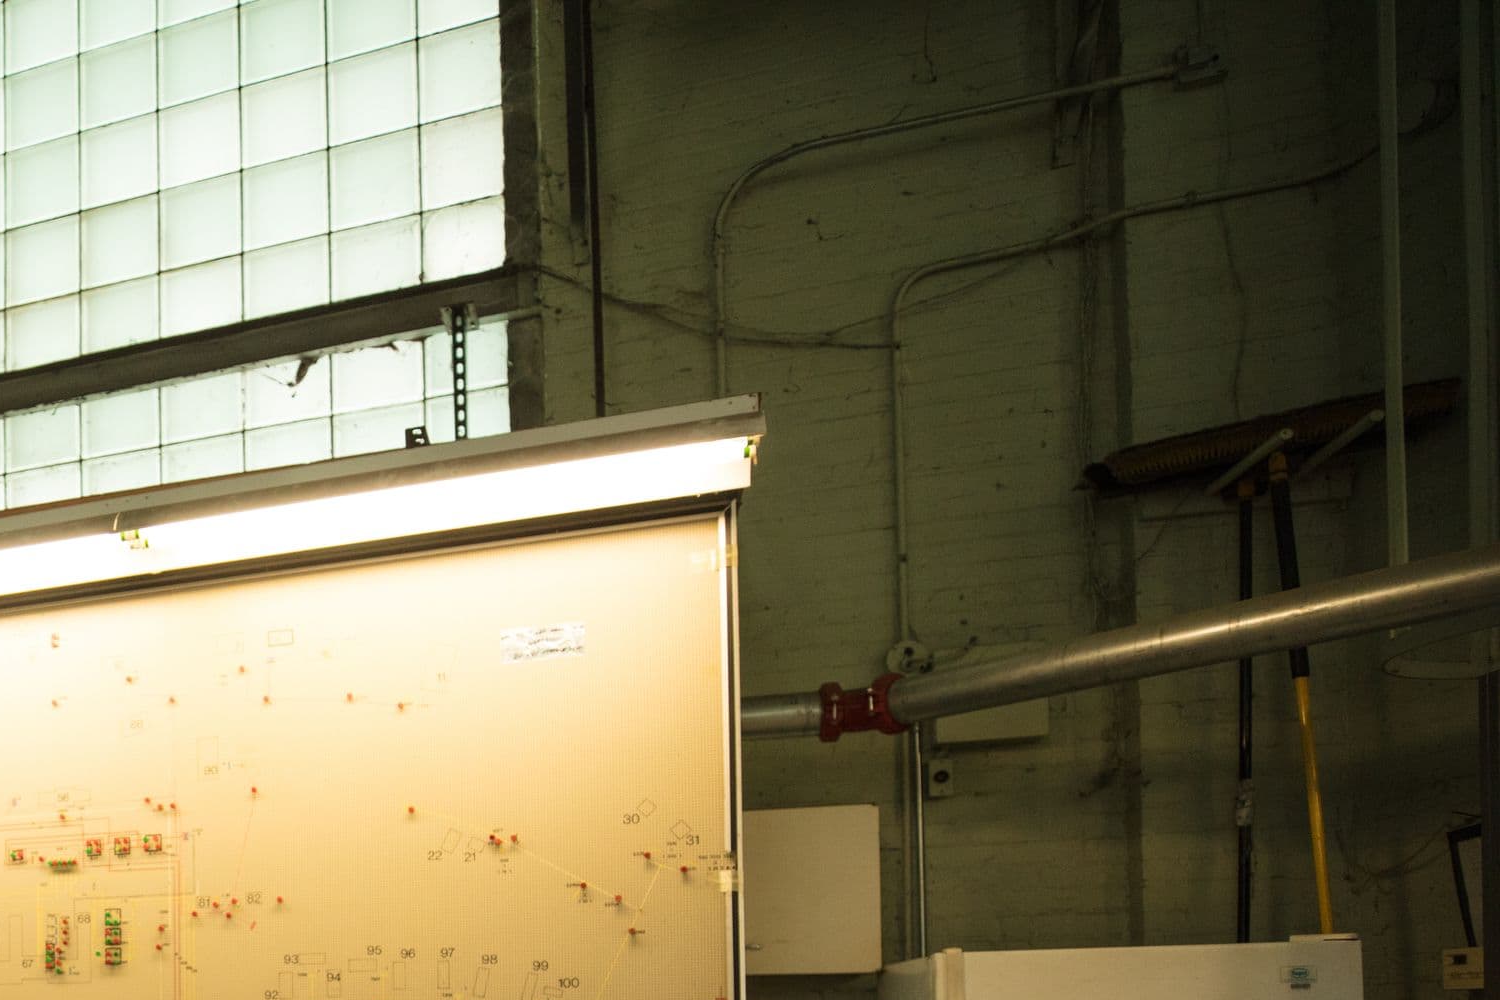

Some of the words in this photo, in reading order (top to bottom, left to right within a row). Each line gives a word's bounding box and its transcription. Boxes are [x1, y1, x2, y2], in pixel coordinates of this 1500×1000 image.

[622, 813, 640, 825] 30
[685, 834, 700, 846] 31
[427, 850, 443, 861] 22
[464, 851, 478, 862] 21
[196, 896, 212, 908] 81
[245, 893, 262, 905] 82
[77, 914, 92, 924] 68
[366, 945, 383, 956] 95
[399, 947, 416, 959] 96
[439, 947, 456, 958] 97
[21, 959, 35, 969] 67
[283, 953, 300, 965] 93
[480, 953, 499, 965] 98
[532, 960, 549, 972] 99
[326, 971, 342, 983] 94
[557, 977, 580, 989] 100
[264, 989, 279, 1000] 92
